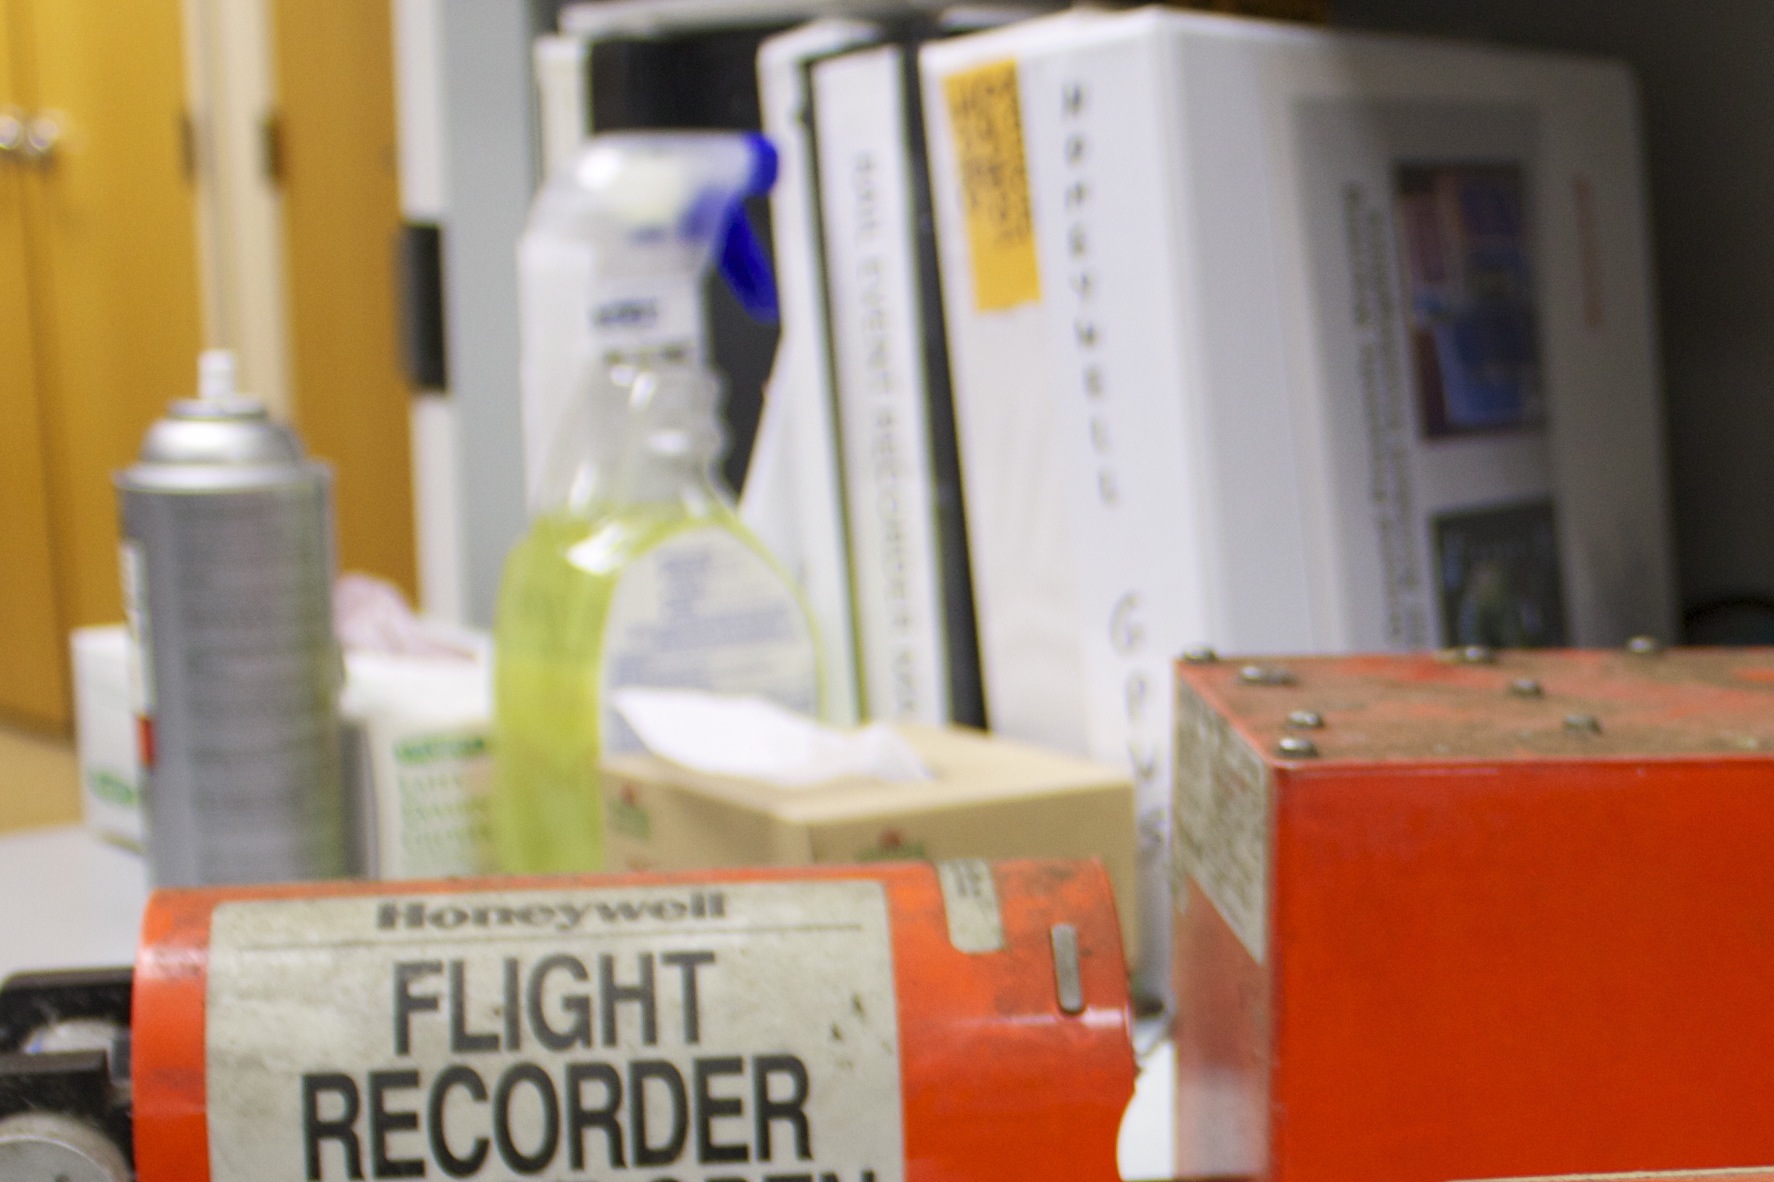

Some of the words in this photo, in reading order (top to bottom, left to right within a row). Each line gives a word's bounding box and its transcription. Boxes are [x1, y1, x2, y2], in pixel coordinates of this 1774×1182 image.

[376, 892, 726, 933] Honeywell
[393, 951, 716, 1056] FLIGHT
[302, 1054, 814, 1182] RECORDER
